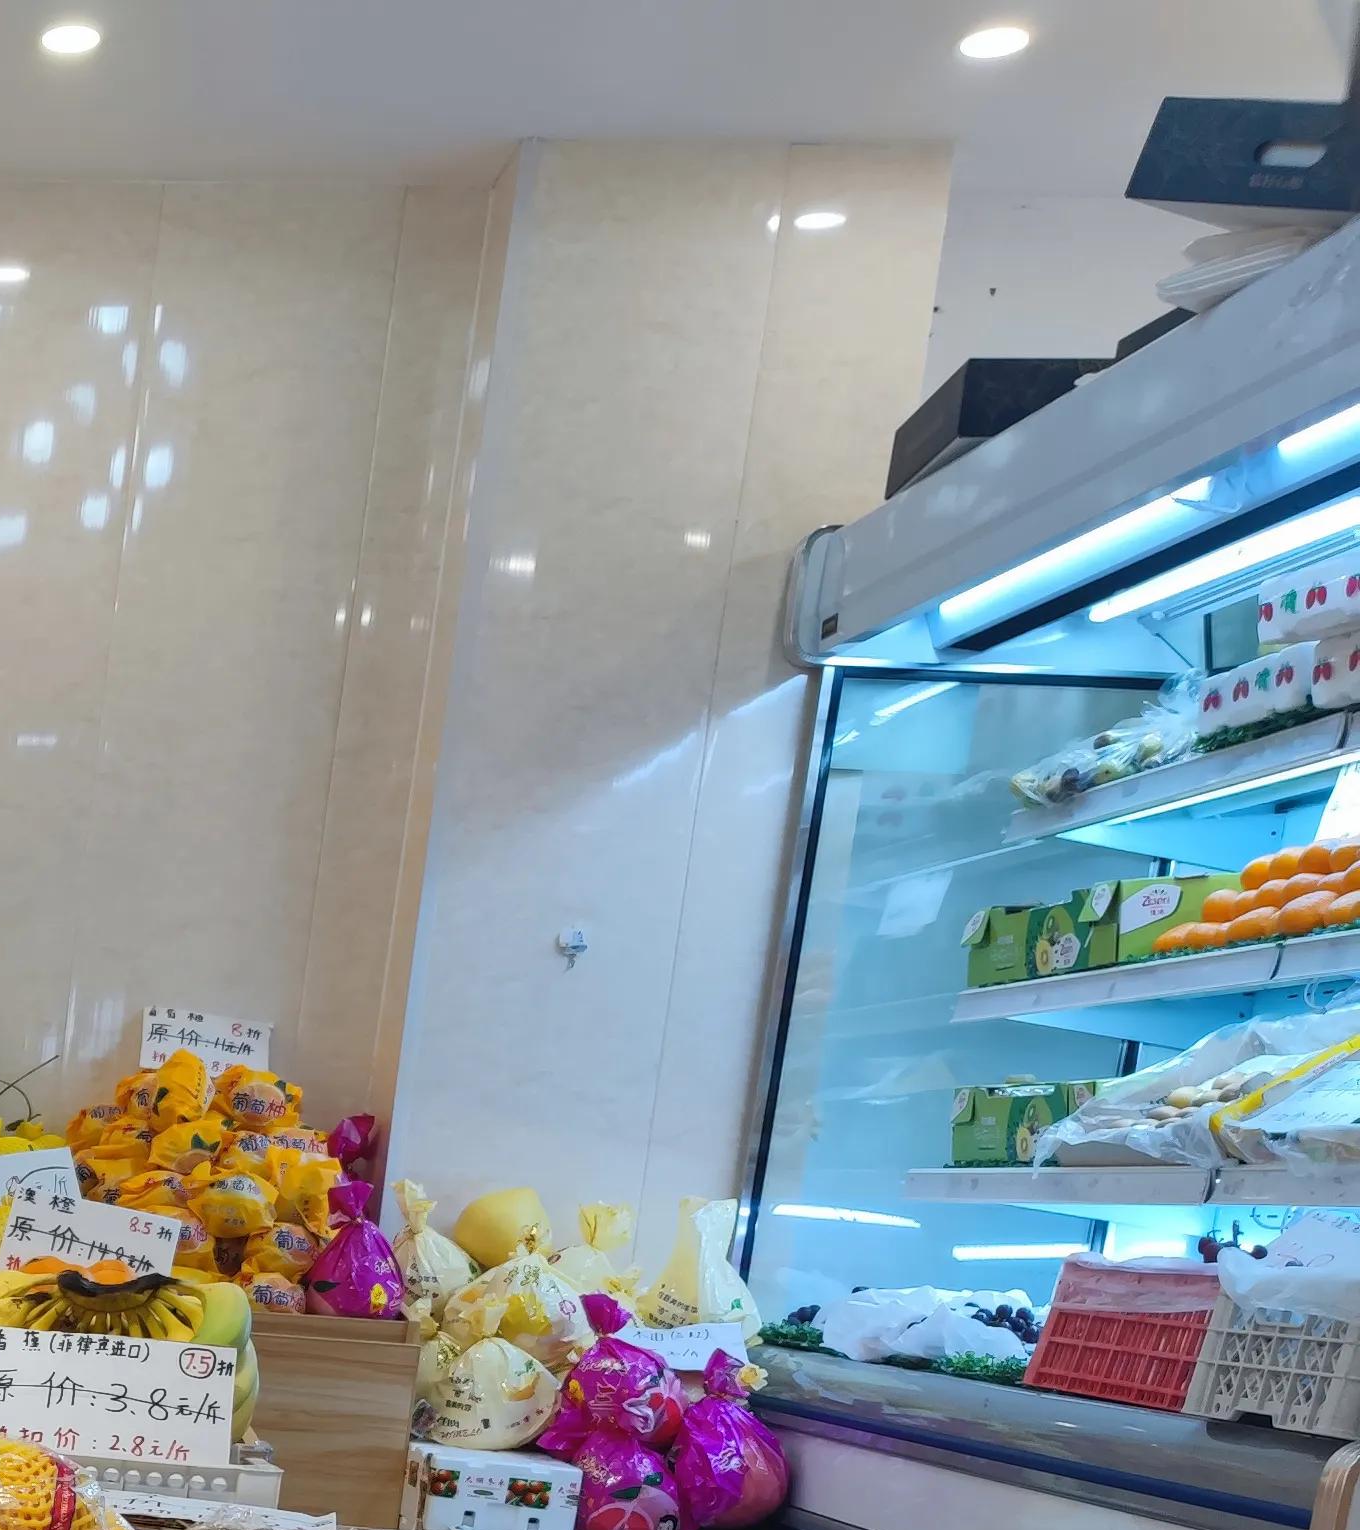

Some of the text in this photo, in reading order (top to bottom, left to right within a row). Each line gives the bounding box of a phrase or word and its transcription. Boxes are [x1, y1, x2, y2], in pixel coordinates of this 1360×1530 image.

[232, 1092, 287, 1118] 葡萄柚
[18, 1187, 77, 1215] 澳橙
[129, 1216, 173, 1242] 8.5折
[182, 1350, 235, 1378] 7.5折
